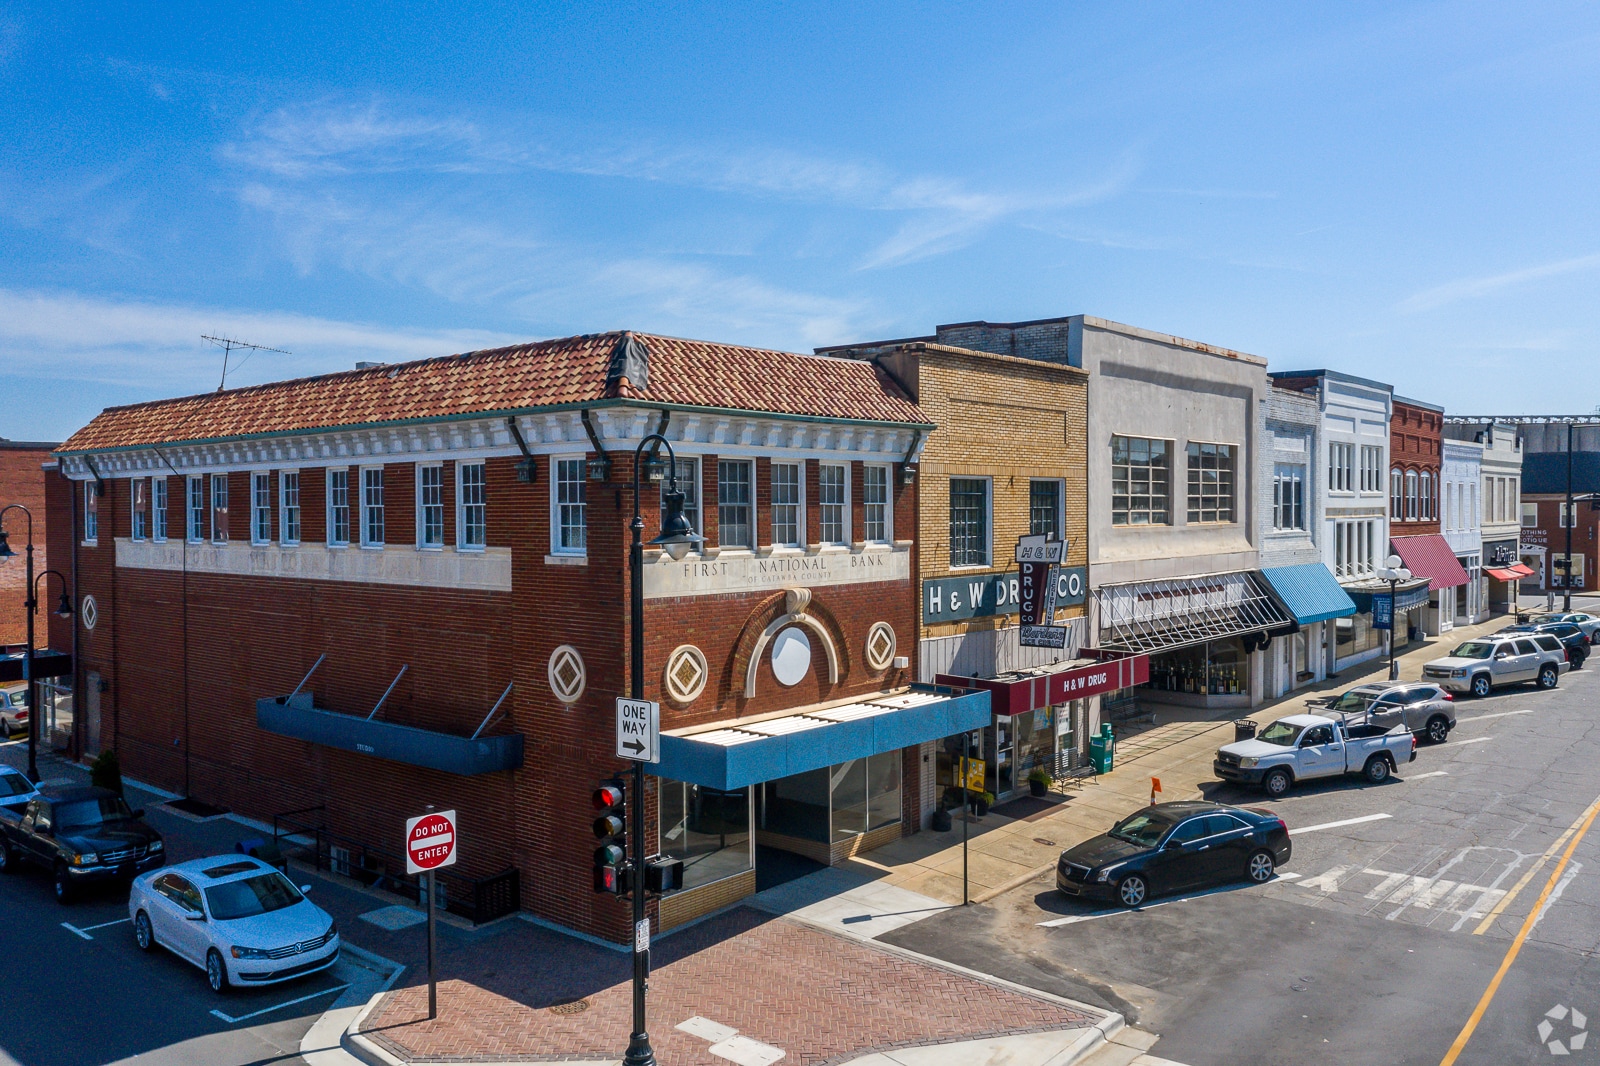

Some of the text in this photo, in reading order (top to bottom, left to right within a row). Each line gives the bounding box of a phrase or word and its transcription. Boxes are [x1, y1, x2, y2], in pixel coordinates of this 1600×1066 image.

[1021, 546, 1058, 558] H & W
[683, 554, 884, 578] FIRST NATIONAL BANK
[747, 571, 832, 584] OF CATAWBA COUNTY
[929, 586, 942, 614] H
[950, 592, 962, 611] &
[968, 582, 984, 609] W
[1058, 573, 1084, 598] CO.
[1023, 563, 1035, 613] DRUG
[1063, 672, 1107, 693] H & W DRUG
[623, 705, 646, 720] ONE
[622, 719, 646, 736] WAY
[415, 821, 448, 838] DO NOT
[418, 845, 449, 861] ENTER
